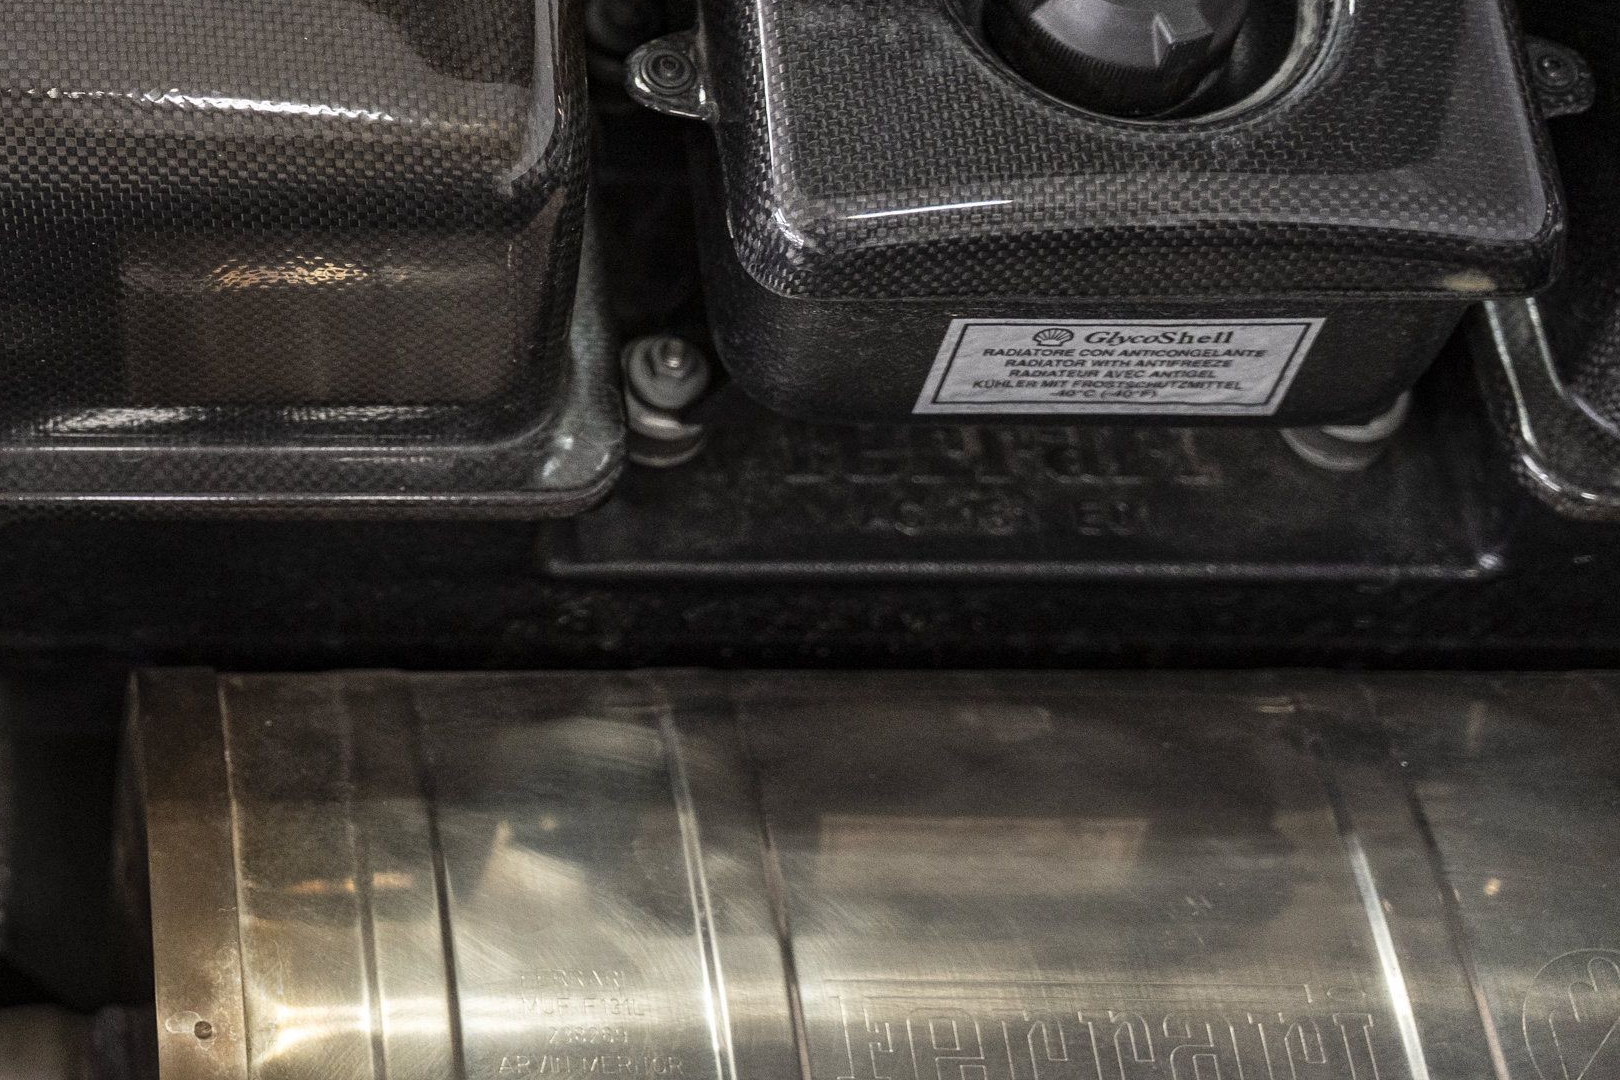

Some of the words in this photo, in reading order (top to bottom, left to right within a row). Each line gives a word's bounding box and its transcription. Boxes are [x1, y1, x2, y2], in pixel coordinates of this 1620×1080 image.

[1084, 331, 1234, 347] GlycoShell
[983, 348, 1074, 357] RADIATORE
[1078, 348, 1114, 357] CON
[1118, 349, 1268, 358] ANTICONGELANTE
[1004, 359, 1086, 367] RADIATOR
[1091, 359, 1131, 367] WITH
[1134, 359, 1233, 368] ANTIFREEZE
[1009, 369, 1099, 378] RADIATEUR
[1102, 370, 1145, 378] AVEC
[1148, 370, 1217, 378] ANTIGEL
[1040, 380, 1068, 388] MIT
[1071, 380, 1244, 390] FROSTSCHUTZMITTEL
